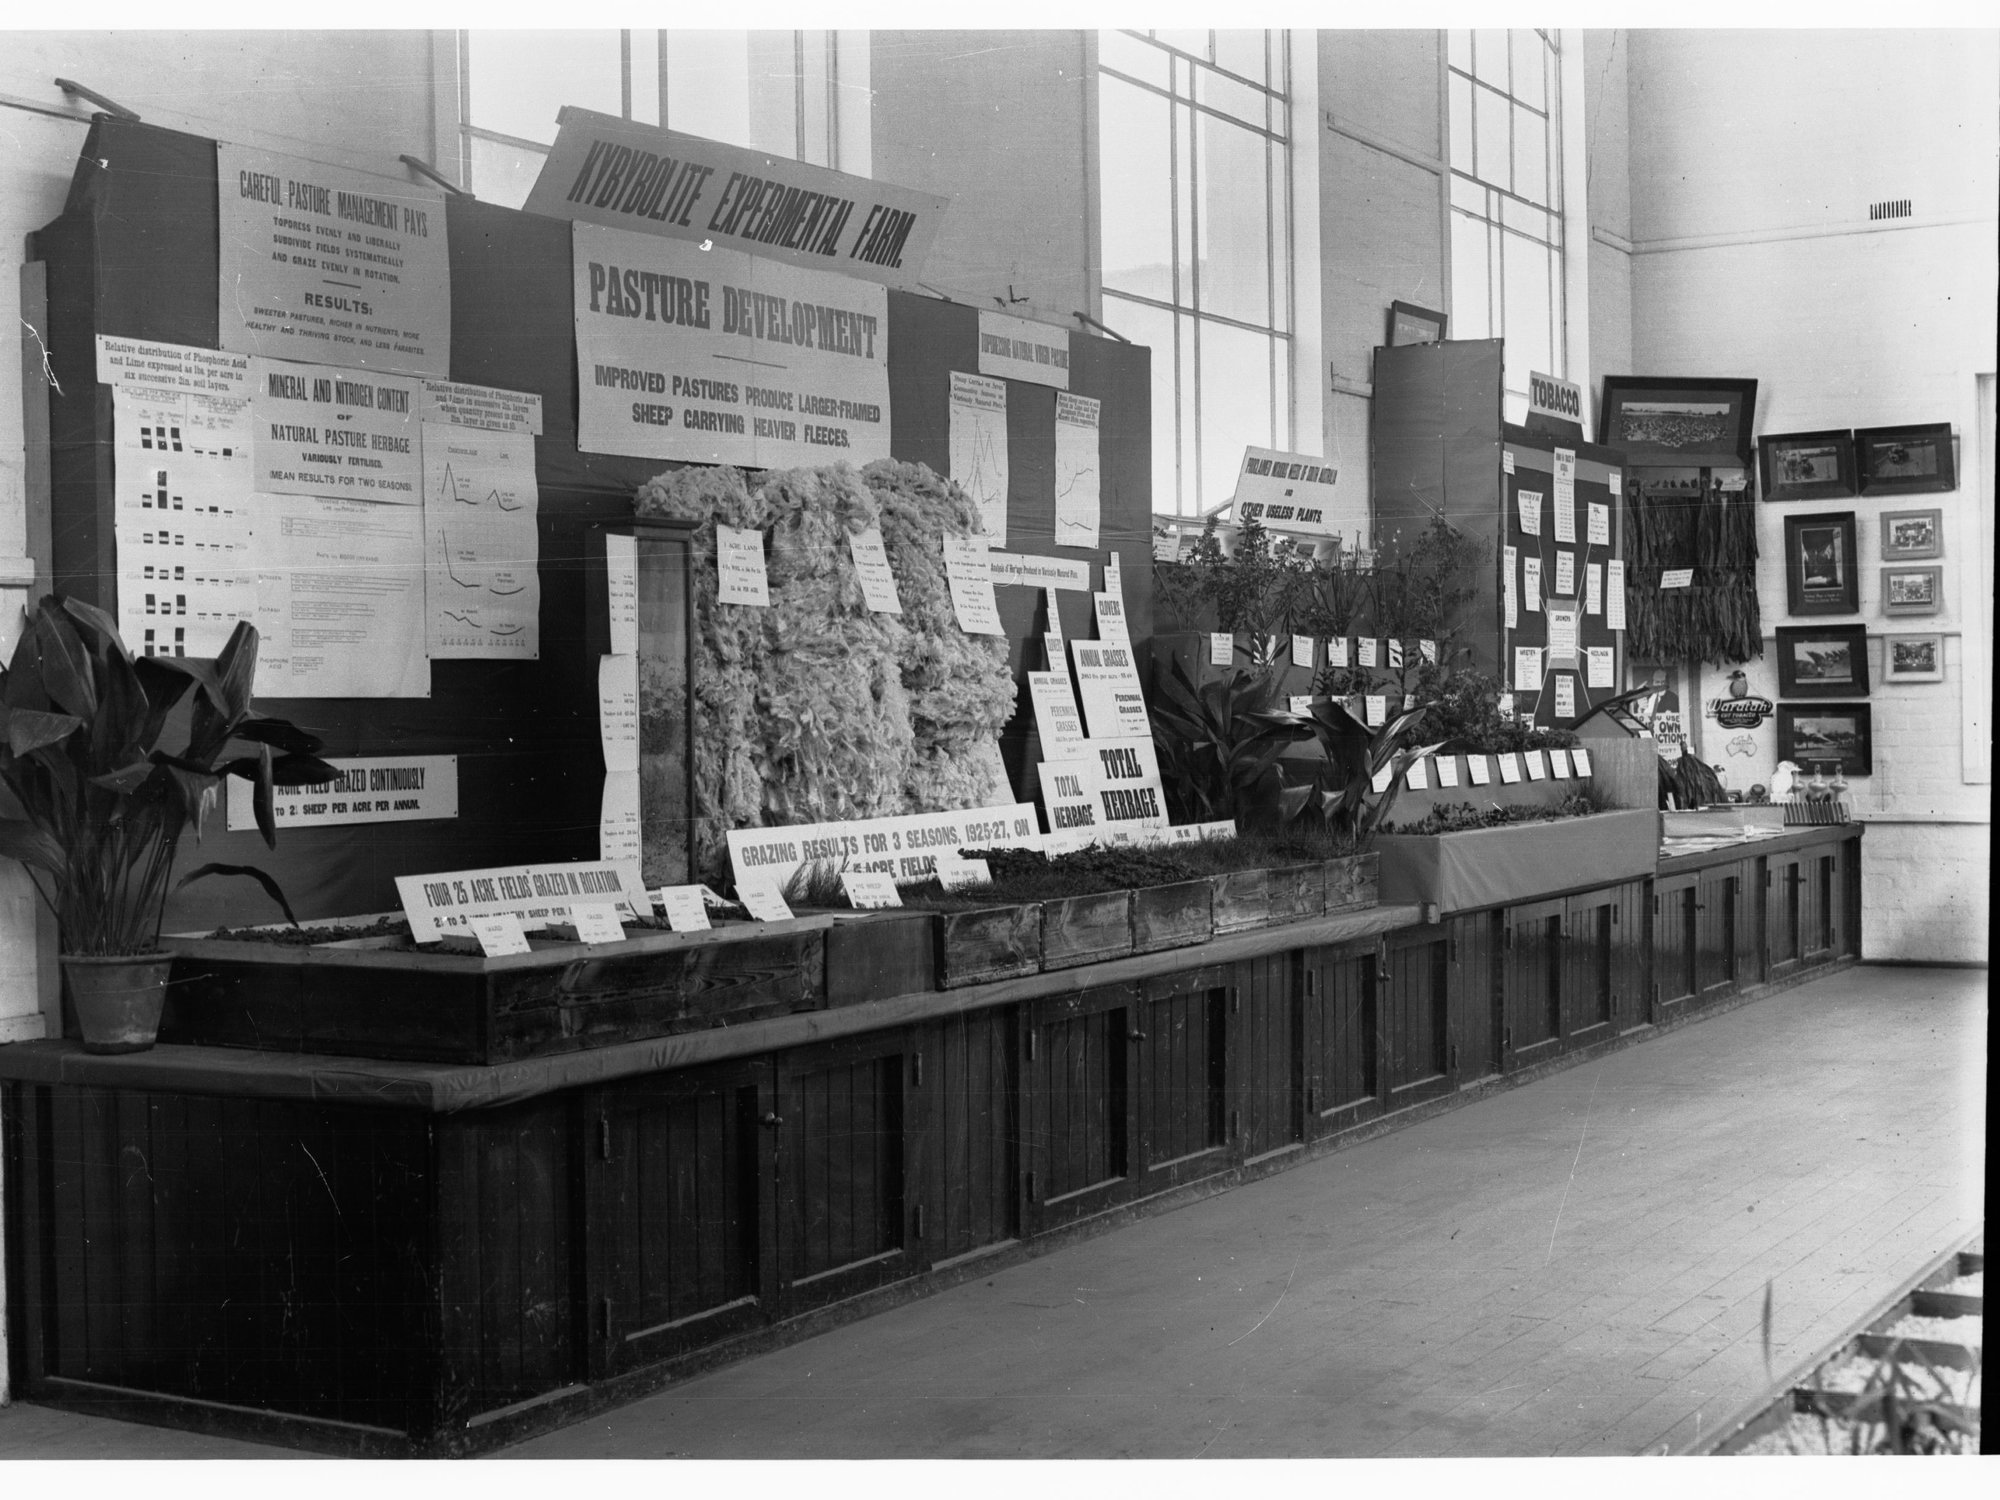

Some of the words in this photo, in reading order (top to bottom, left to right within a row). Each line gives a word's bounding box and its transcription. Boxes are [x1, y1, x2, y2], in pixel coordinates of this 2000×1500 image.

[240, 170, 283, 206] CAREFUL
[289, 180, 331, 215] PASTURE
[337, 192, 398, 231] MANAGEMENT
[404, 208, 428, 237] PAYS
[567, 139, 714, 227] KYBYBOLITE
[708, 171, 854, 256] EXPERIMENTAL
[849, 203, 917, 269] FARM.
[273, 216, 311, 233] TOPDRESS
[316, 225, 342, 239] EVENLY
[347, 232, 361, 243] AND
[365, 236, 401, 251] LIBERALLY
[273, 234, 311, 250] SUBDIVIDE
[316, 242, 340, 255] FIELDS
[345, 248, 404, 268] SYSTEMATICALLY
[272, 251, 287, 263] AND
[293, 256, 316, 268] GRAZE
[321, 260, 348, 275] EVENLY
[353, 266, 360, 276] IN
[364, 270, 401, 284] ROTATION.
[304, 292, 373, 315] RESULTS:
[588, 261, 710, 330] PASTURE
[722, 284, 877, 359] DEVELOPMENT
[245, 320, 276, 332] HEALTHY
[281, 325, 294, 335] AND
[299, 329, 330, 341] THRIVING
[334, 333, 356, 345] STOCK,
[360, 337, 372, 347] AND
[375, 341, 390, 350] LESS
[254, 306, 286, 319] SWEETER
[290, 312, 326, 326] PASTURES,
[329, 318, 352, 329] RICHER
[355, 322, 362, 331] IN
[365, 324, 400, 338] NUTRIENTS,
[403, 330, 420, 340] MORE
[105, 341, 135, 354] Relative
[137, 344, 182, 360] distribution
[184, 351, 191, 360] of
[193, 352, 230, 368] Phosphoric
[231, 358, 247, 369] Acid
[110, 356, 123, 365] and
[125, 357, 145, 368] Lime
[147, 361, 182, 375] expressed
[184, 366, 192, 374] as
[207, 369, 218, 379] per
[220, 370, 233, 379] acre
[235, 372, 243, 381] in
[124, 370, 136, 380] six
[138, 373, 176, 385] successive
[193, 378, 206, 388] soil
[208, 380, 230, 391] layers.
[268, 373, 308, 401] MINERAL
[313, 378, 331, 403] AND
[335, 380, 374, 409] NITROGEN
[377, 387, 410, 414] CONTENT
[426, 382, 451, 394] Relative
[454, 385, 487, 398] distribution
[488, 390, 494, 399] of
[495, 391, 523, 404] Phosphoric
[524, 395, 537, 406] Acid
[436, 394, 447, 402] and
[594, 364, 665, 394] IMPROVED
[672, 374, 739, 403] PASTURES
[745, 385, 794, 412] PRODUCE
[798, 393, 880, 423] LARGER-FRAMED
[1531, 377, 1580, 418] TOBACCO
[337, 413, 353, 421] OF
[632, 402, 673, 425] SHEEP
[683, 408, 745, 435] CARRYING
[753, 416, 797, 442] HEAVIER
[804, 423, 850, 448] FLEECES.
[271, 423, 319, 444] NATURAL
[325, 428, 368, 449] PASTURE
[371, 433, 410, 454] HERBAGE
[302, 452, 342, 465] VARIOUSLY
[348, 456, 383, 469] FERTILISED.
[269, 470, 295, 481] (MEAN
[298, 472, 336, 485] RESULTS
[338, 475, 355, 486] FOR
[357, 477, 375, 488] TWO
[1240, 502, 1264, 518] OTHER
[1266, 504, 1294, 520] USELESS
[1296, 507, 1322, 524] PLANTS.
[1079, 649, 1102, 667] ANNUAL
[1101, 649, 1129, 667] GRASSES
[1119, 705, 1143, 714] GRASSES
[1665, 714, 1680, 722] USE
[1707, 698, 1771, 713] Waratah
[1659, 720, 1681, 733] OWN
[1099, 747, 1143, 780] TOTAL
[370, 767, 426, 792] CONTINUOUSLY
[1054, 774, 1083, 798] TOTAL
[275, 807, 285, 817] TO
[303, 803, 328, 815] SHEEP
[332, 802, 348, 814] PER
[352, 801, 372, 813] ACRE
[375, 800, 390, 812] PER
[393, 799, 421, 811] ANNUM.
[1053, 804, 1095, 829] HERBAGE
[1100, 787, 1159, 821] HERBAGE
[741, 842, 798, 867] GRAZING
[802, 835, 859, 861] RESULTS
[863, 831, 888, 854] FOR
[893, 831, 902, 850] 3
[906, 825, 962, 849] SEASONS,
[1014, 818, 1030, 837] ON
[900, 855, 938, 877] FIELDS
[423, 882, 453, 908] FOUR
[452, 881, 469, 904] 25
[470, 877, 499, 903] ACRE
[498, 875, 533, 900] FIELDS
[532, 872, 569, 897] GRAZED
[567, 871, 581, 895] IN
[580, 870, 623, 895] ROTATION
[460, 914, 468, 926] 3
[528, 908, 549, 919] SHEEP
[552, 906, 566, 917] PER
